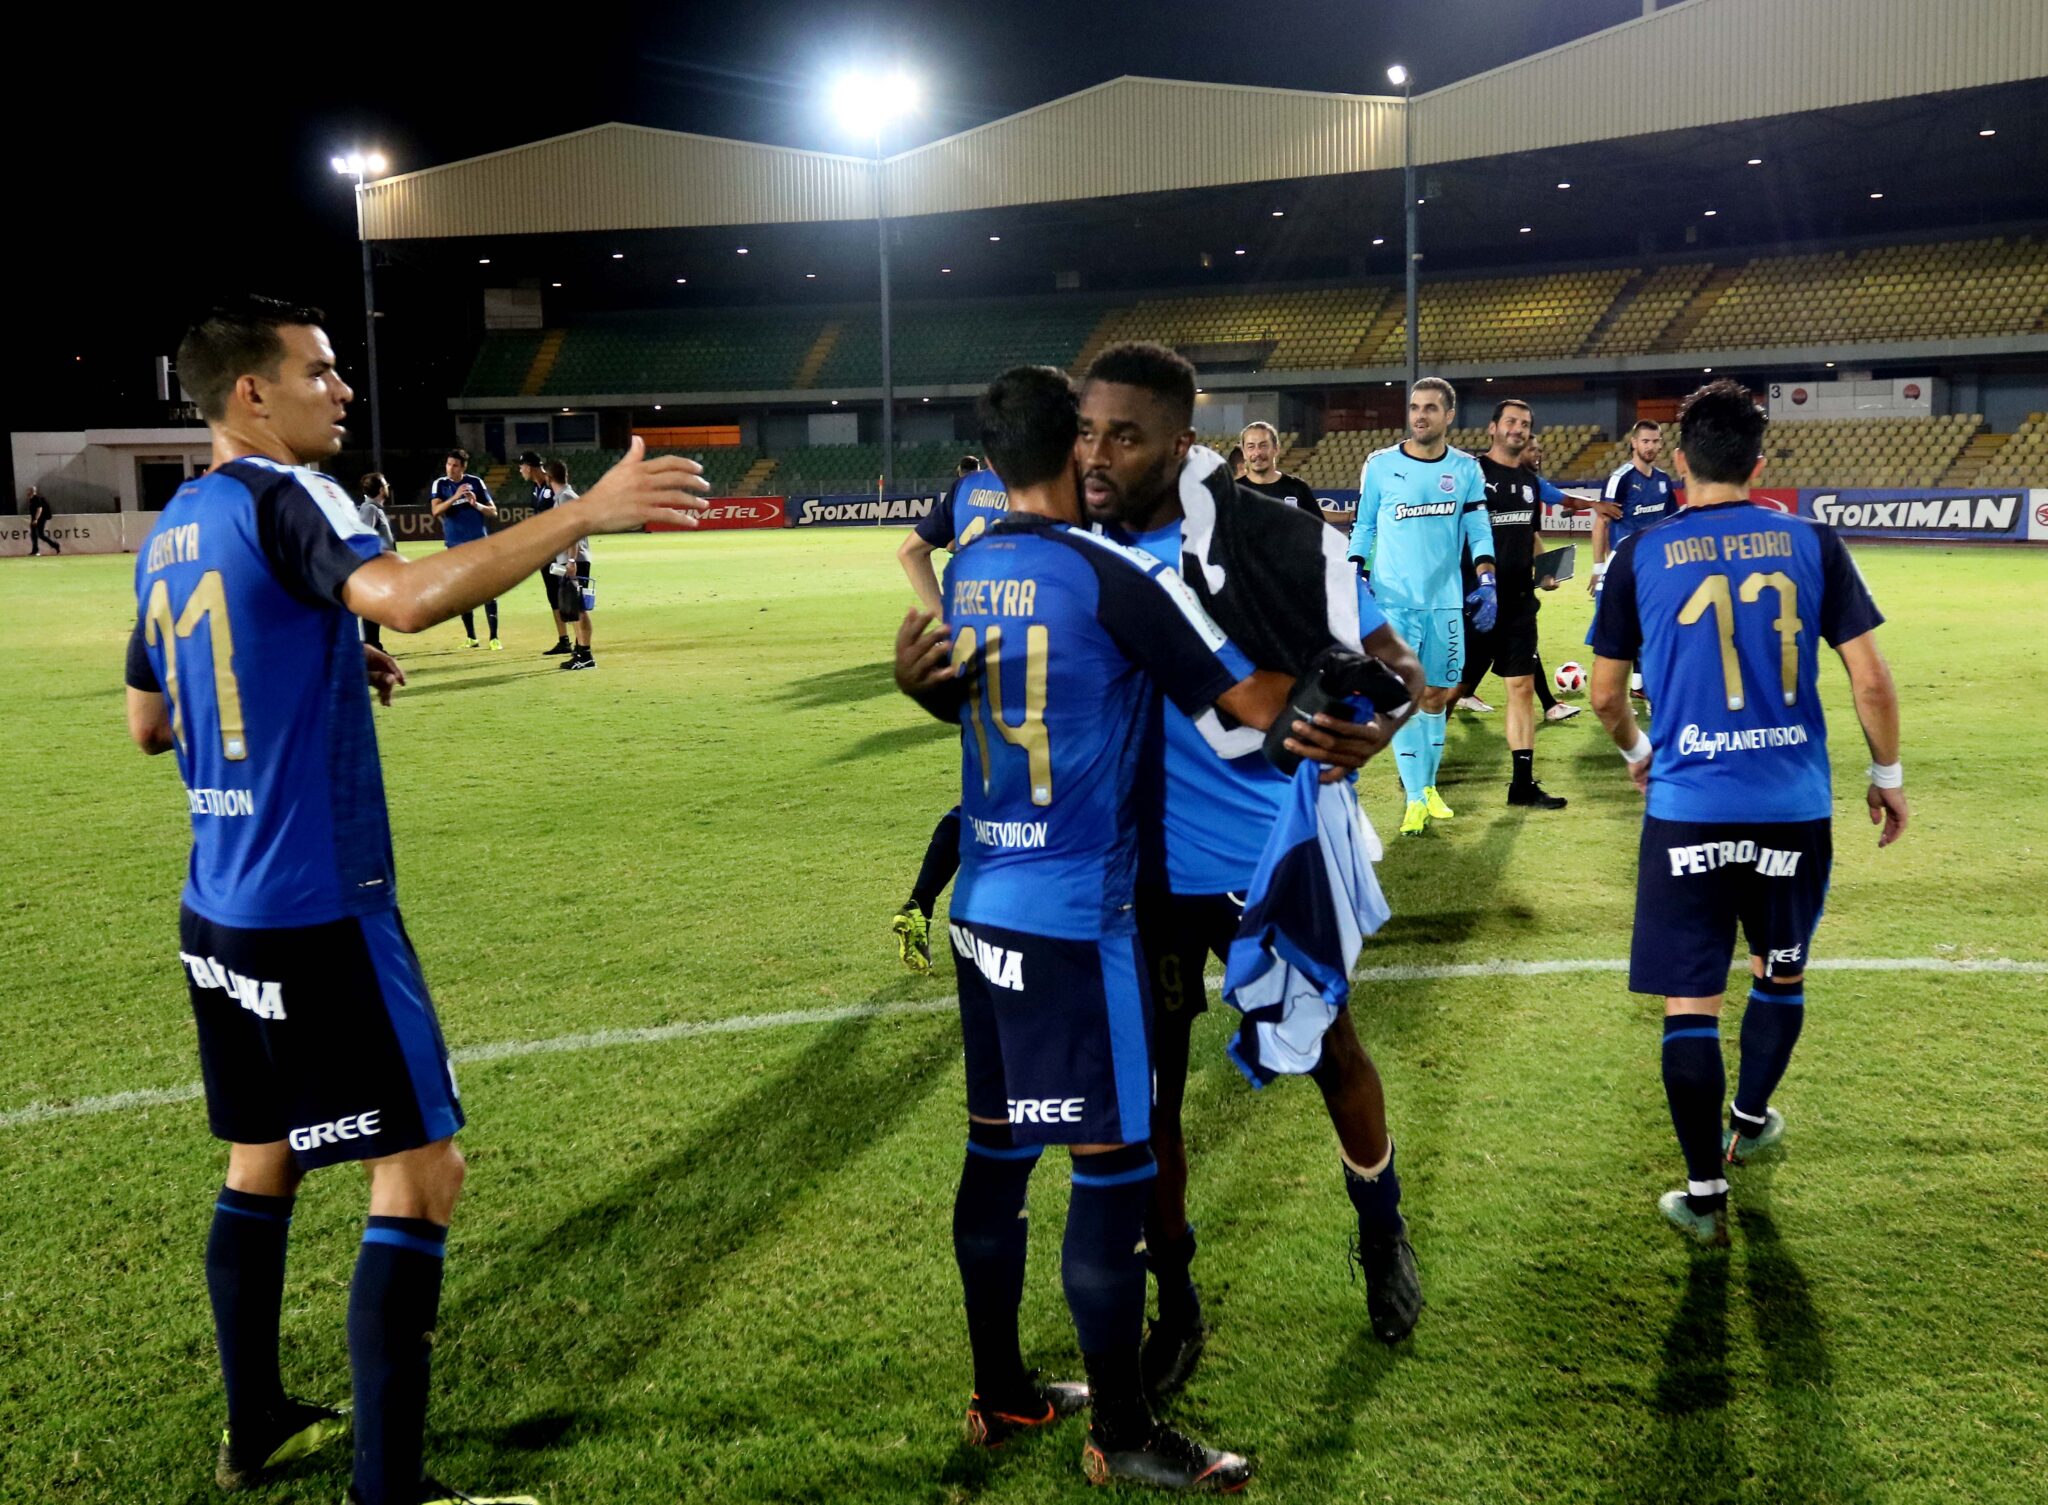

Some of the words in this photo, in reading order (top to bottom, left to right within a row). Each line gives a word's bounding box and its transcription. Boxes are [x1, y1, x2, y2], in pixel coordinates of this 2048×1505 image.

[1771, 385, 1782, 399] 3
[387, 513, 445, 534] UR
[799, 499, 934, 525] STOIXIMAN
[1394, 502, 1457, 521] STOIXIMAN
[1811, 494, 2018, 530] STOIXIMAN
[1663, 536, 1718, 569] JOAO
[1723, 531, 1793, 561] PEDRO
[953, 579, 1036, 617] PEREYRA
[1677, 571, 1804, 711] 17
[145, 569, 248, 761] 11
[952, 624, 1052, 806] 14
[1715, 725, 1808, 753] PLANETVISION
[289, 1109, 382, 1152] GREE
